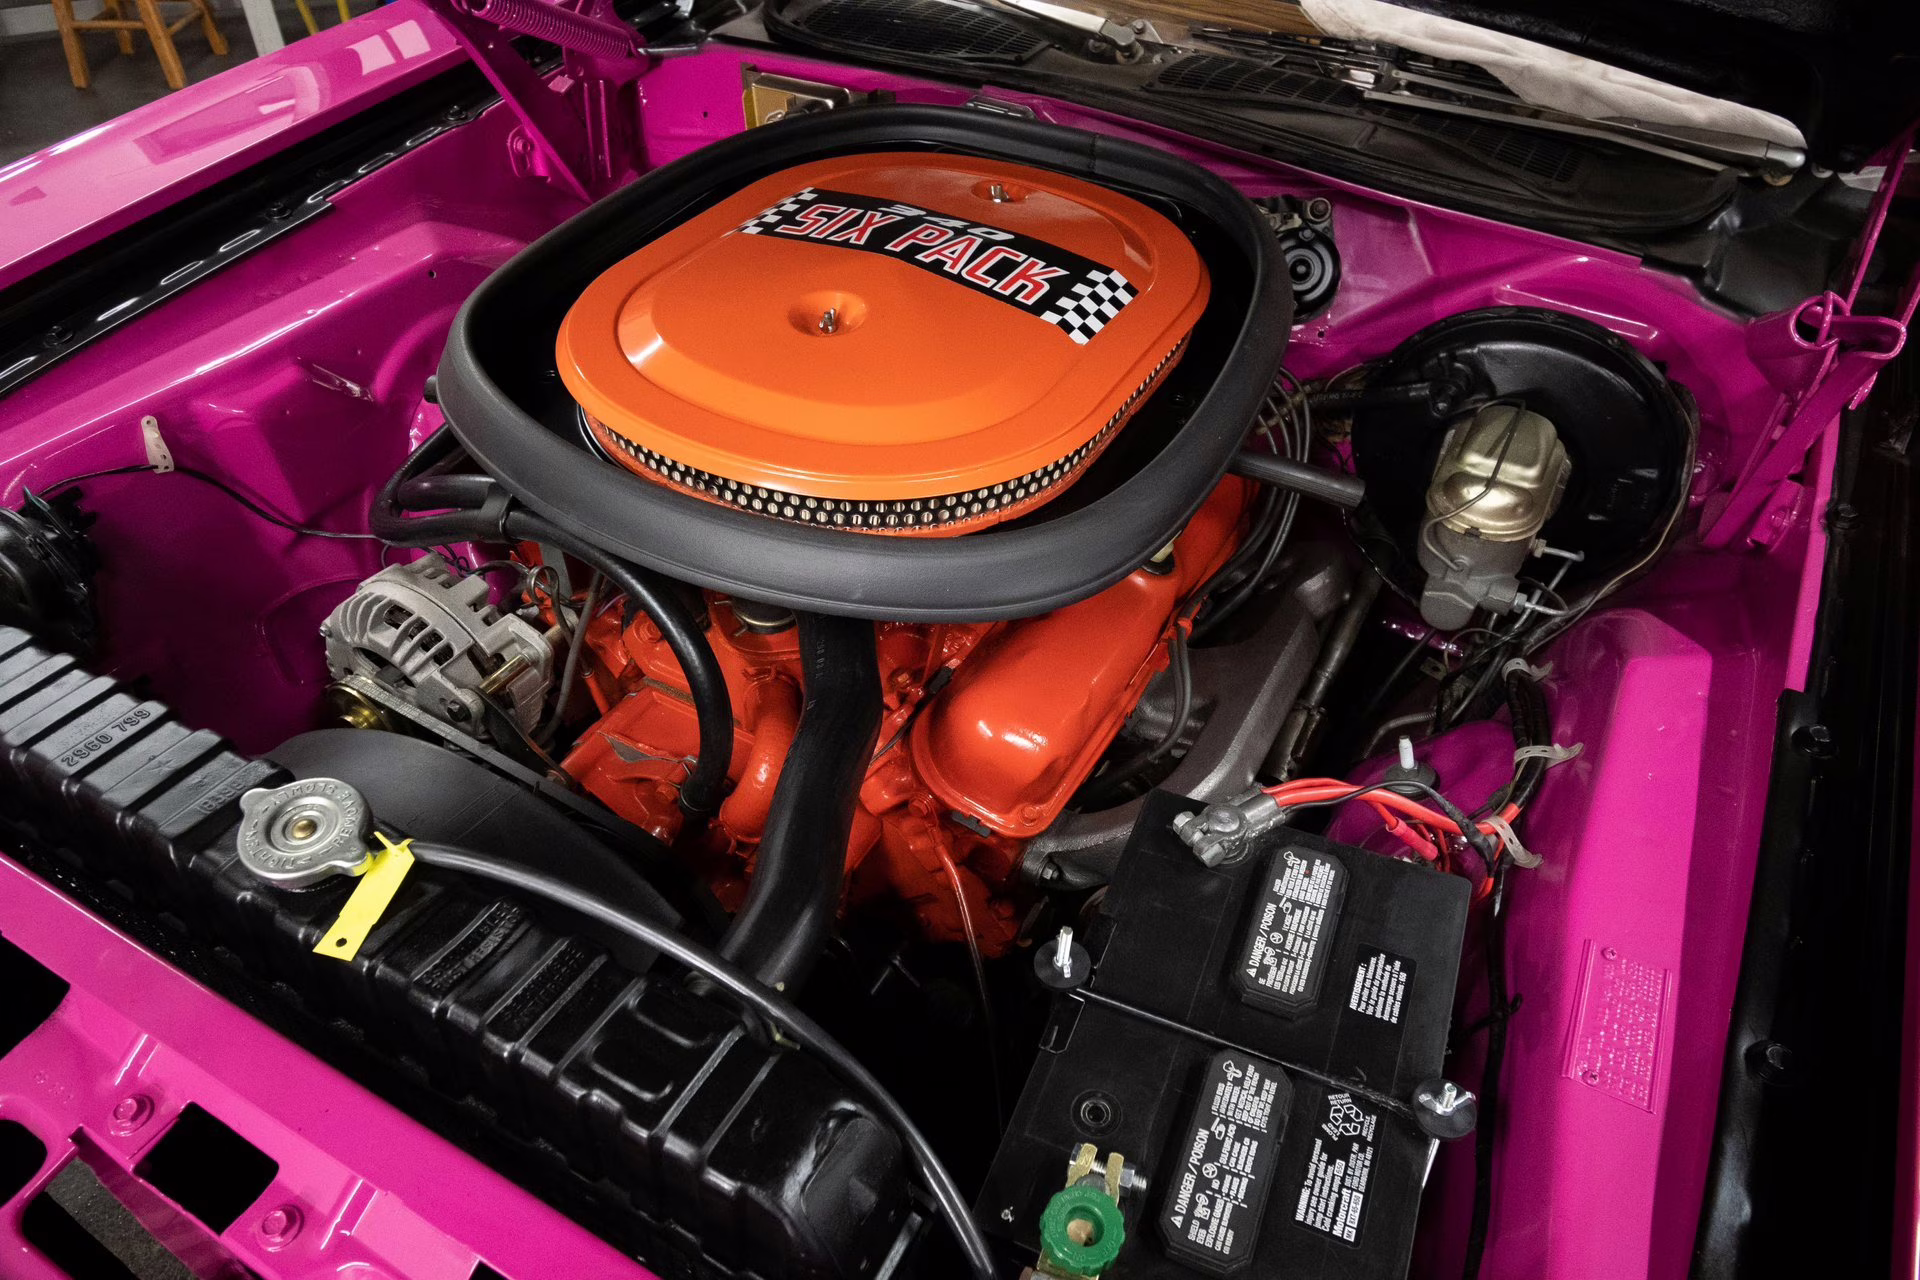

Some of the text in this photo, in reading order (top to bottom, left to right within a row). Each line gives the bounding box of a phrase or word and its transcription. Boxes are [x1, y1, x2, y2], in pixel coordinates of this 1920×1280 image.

[877, 204, 1015, 241] 340
[774, 203, 1070, 305] SIX PACK
[61, 708, 151, 767] 2960 799
[1249, 936, 1267, 967] DANGER
[1260, 902, 1277, 931] POISON
[1175, 1172, 1196, 1214] DANGER
[1189, 1128, 1209, 1165] POISON
[1295, 1187, 1311, 1221] WARNING:
[1311, 1138, 1323, 1166] personal
[1321, 1217, 1331, 1232] Cold
[1326, 1192, 1339, 1217] cranking
[1332, 1188, 1351, 1237] Motorcraft
[1345, 1228, 1353, 1239] MK
